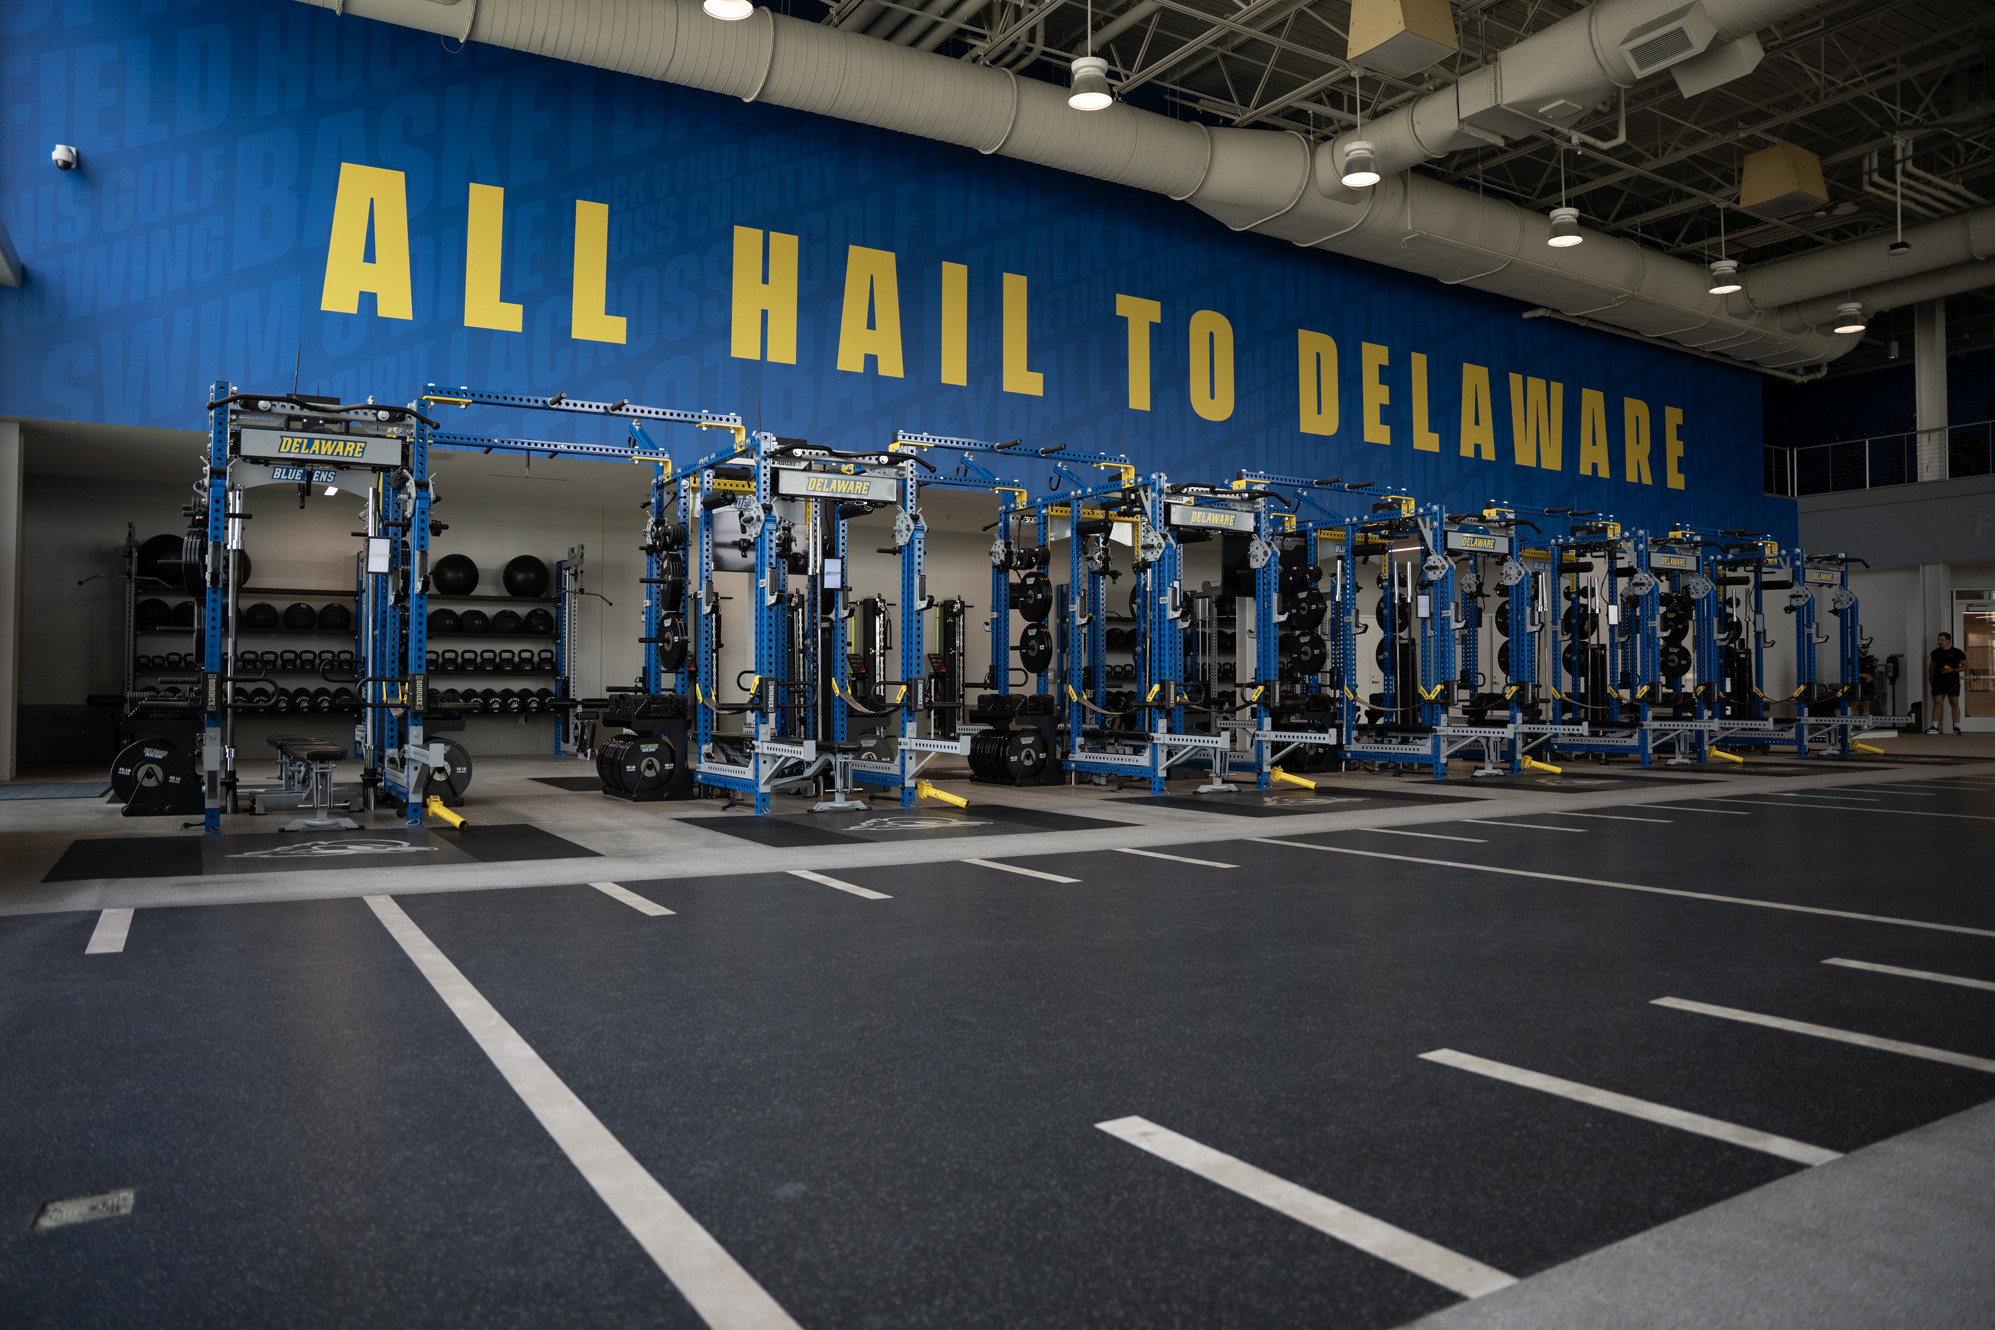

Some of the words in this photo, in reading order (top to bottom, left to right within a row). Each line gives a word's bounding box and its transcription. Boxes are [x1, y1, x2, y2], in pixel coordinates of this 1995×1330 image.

[101, 144, 224, 233] GOLF
[560, 197, 678, 280] COSS
[320, 163, 627, 345] ALL
[731, 226, 1044, 397] HAIL
[1116, 293, 1235, 422] TO
[1298, 328, 1686, 490] DELAWARE
[280, 436, 365, 457] DELAWARE
[273, 468, 304, 480] BLUE
[305, 469, 336, 482] ENS
[807, 477, 871, 495] DELAWARE
[1190, 510, 1235, 526] DELAWARE
[1462, 536, 1495, 549] DELAWARE
[1661, 556, 1686, 567] DELAWARE
